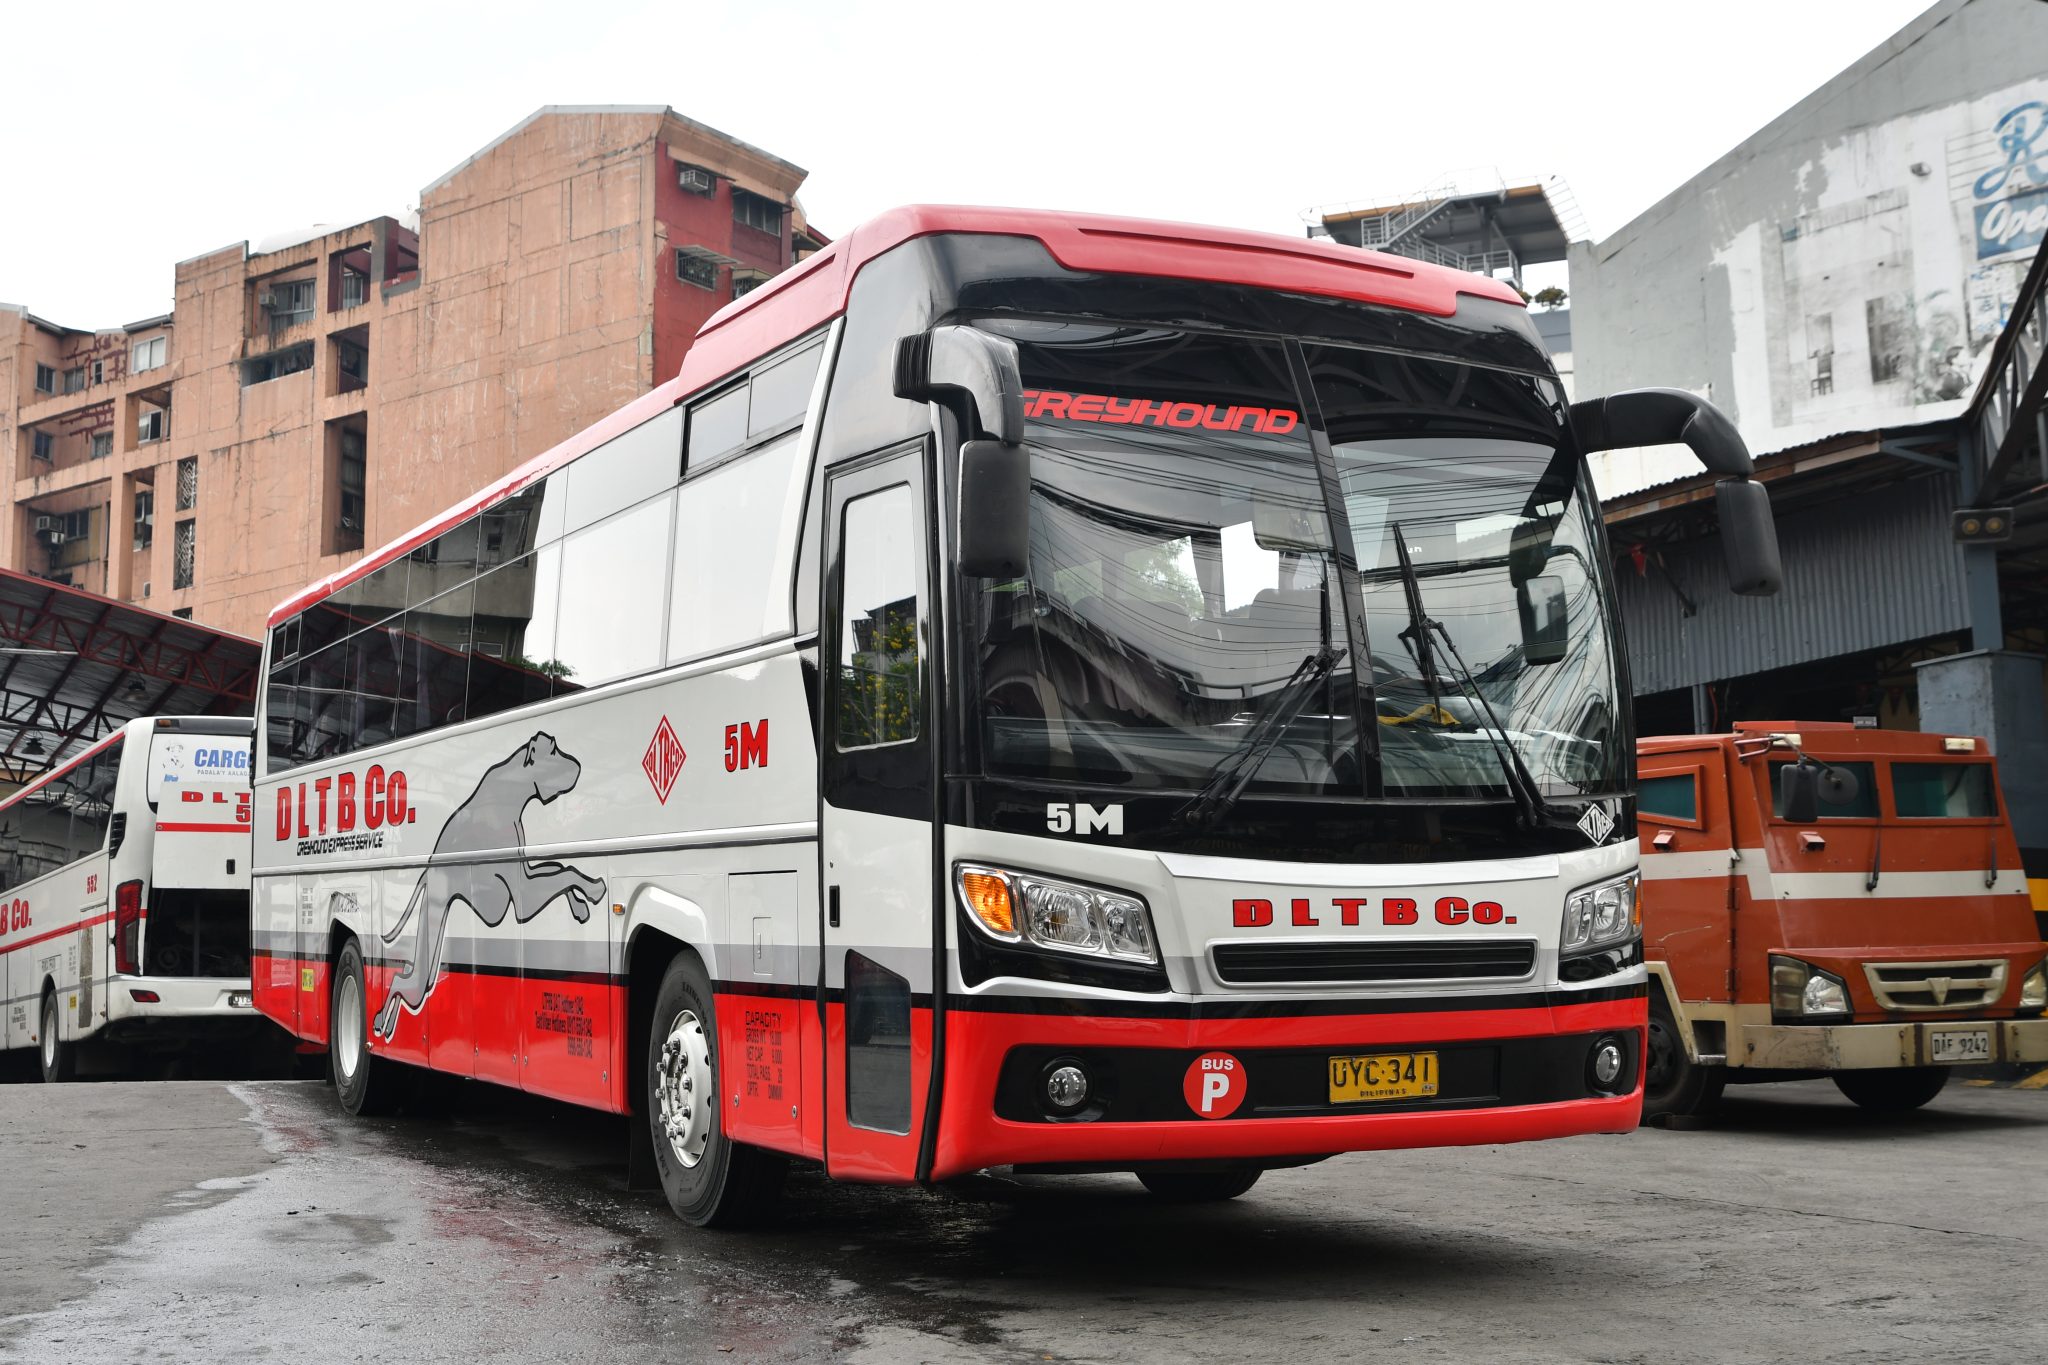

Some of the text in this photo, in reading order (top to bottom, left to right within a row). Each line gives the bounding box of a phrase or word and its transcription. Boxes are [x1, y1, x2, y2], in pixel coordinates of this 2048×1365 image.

[725, 718, 768, 773] 5M
[1046, 802, 1124, 836] 5M
[86, 874, 98, 894] 552
[745, 1010, 782, 1028] CAPACITY
[1960, 1038, 1988, 1054] 9242
[1201, 1059, 1234, 1070] BUS
[1201, 1072, 1230, 1112] P
